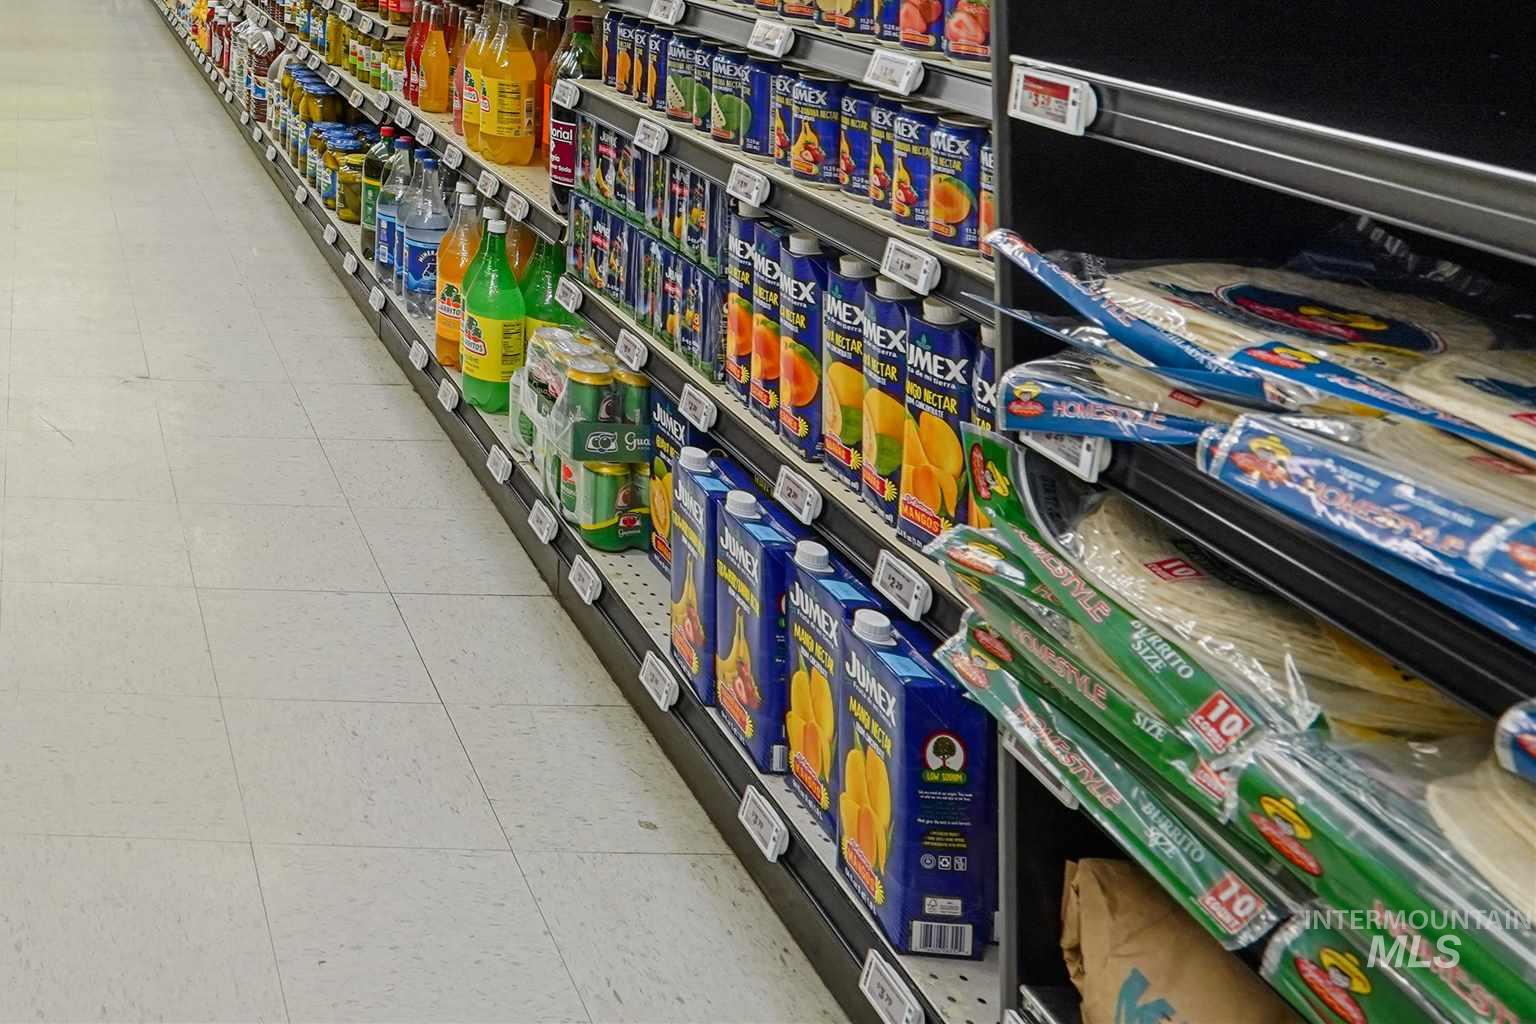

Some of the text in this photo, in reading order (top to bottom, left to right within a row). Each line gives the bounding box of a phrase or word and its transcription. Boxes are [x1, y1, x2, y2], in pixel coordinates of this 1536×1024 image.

[754, 253, 781, 280] MEX
[780, 275, 816, 304] MEX
[923, 385, 958, 415] NECTAR
[624, 432, 651, 451] Gua
[652, 402, 686, 445] JUMEX
[674, 479, 704, 530] JUMEX
[902, 499, 943, 536] MANGOS
[720, 526, 759, 585] JUMEX
[789, 580, 839, 648] JUMEX
[1131, 636, 1168, 674] SIZE
[845, 651, 897, 723] JUMEX
[1133, 711, 1165, 742] SIZE
[1207, 699, 1245, 738] 10
[1142, 801, 1207, 863] BURRITO
[1219, 875, 1256, 915] 10
